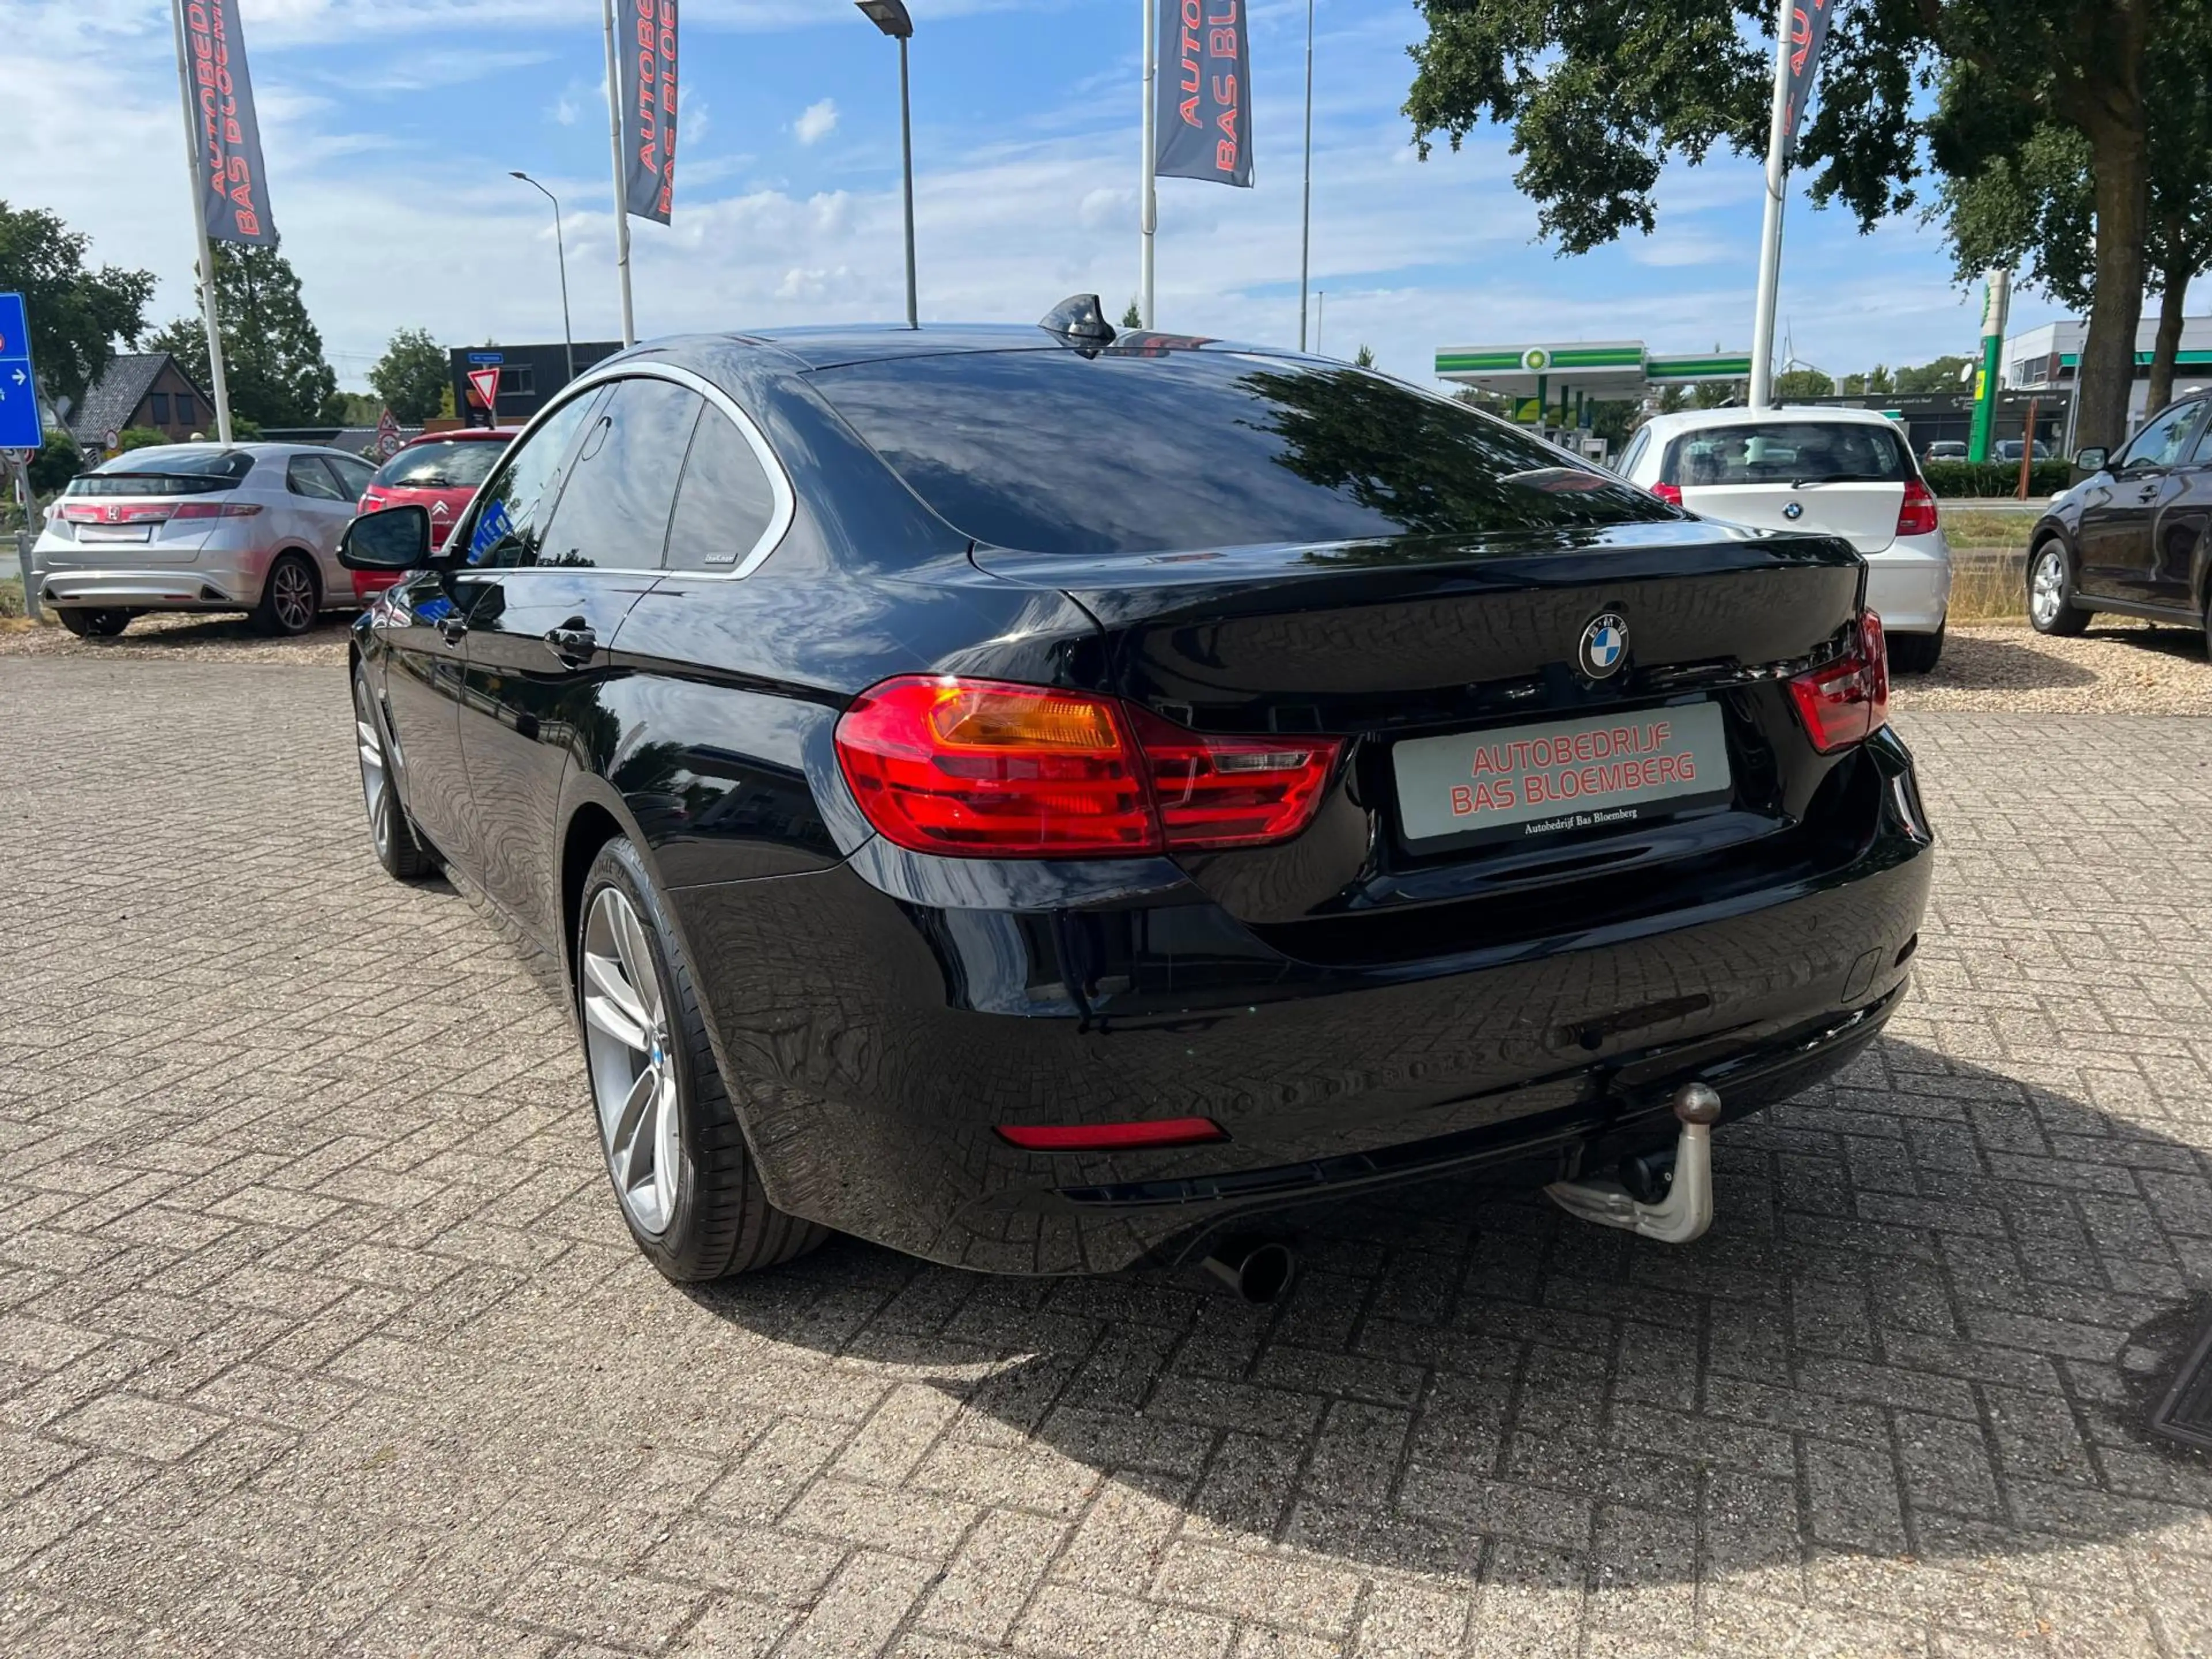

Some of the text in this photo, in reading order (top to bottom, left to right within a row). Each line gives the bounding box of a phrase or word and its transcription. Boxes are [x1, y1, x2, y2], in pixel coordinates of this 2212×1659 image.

[188, 0, 226, 200] AUTOBED
[211, 0, 260, 235] BAS BLOEM
[1212, 74, 1238, 172] BAS
[1450, 751, 1696, 816] BAS BLOEMBERG
[1472, 721, 1671, 778] AUTOBEDRIJF
[1525, 808, 1638, 835] Autobedrijf Bas Bloemberg
